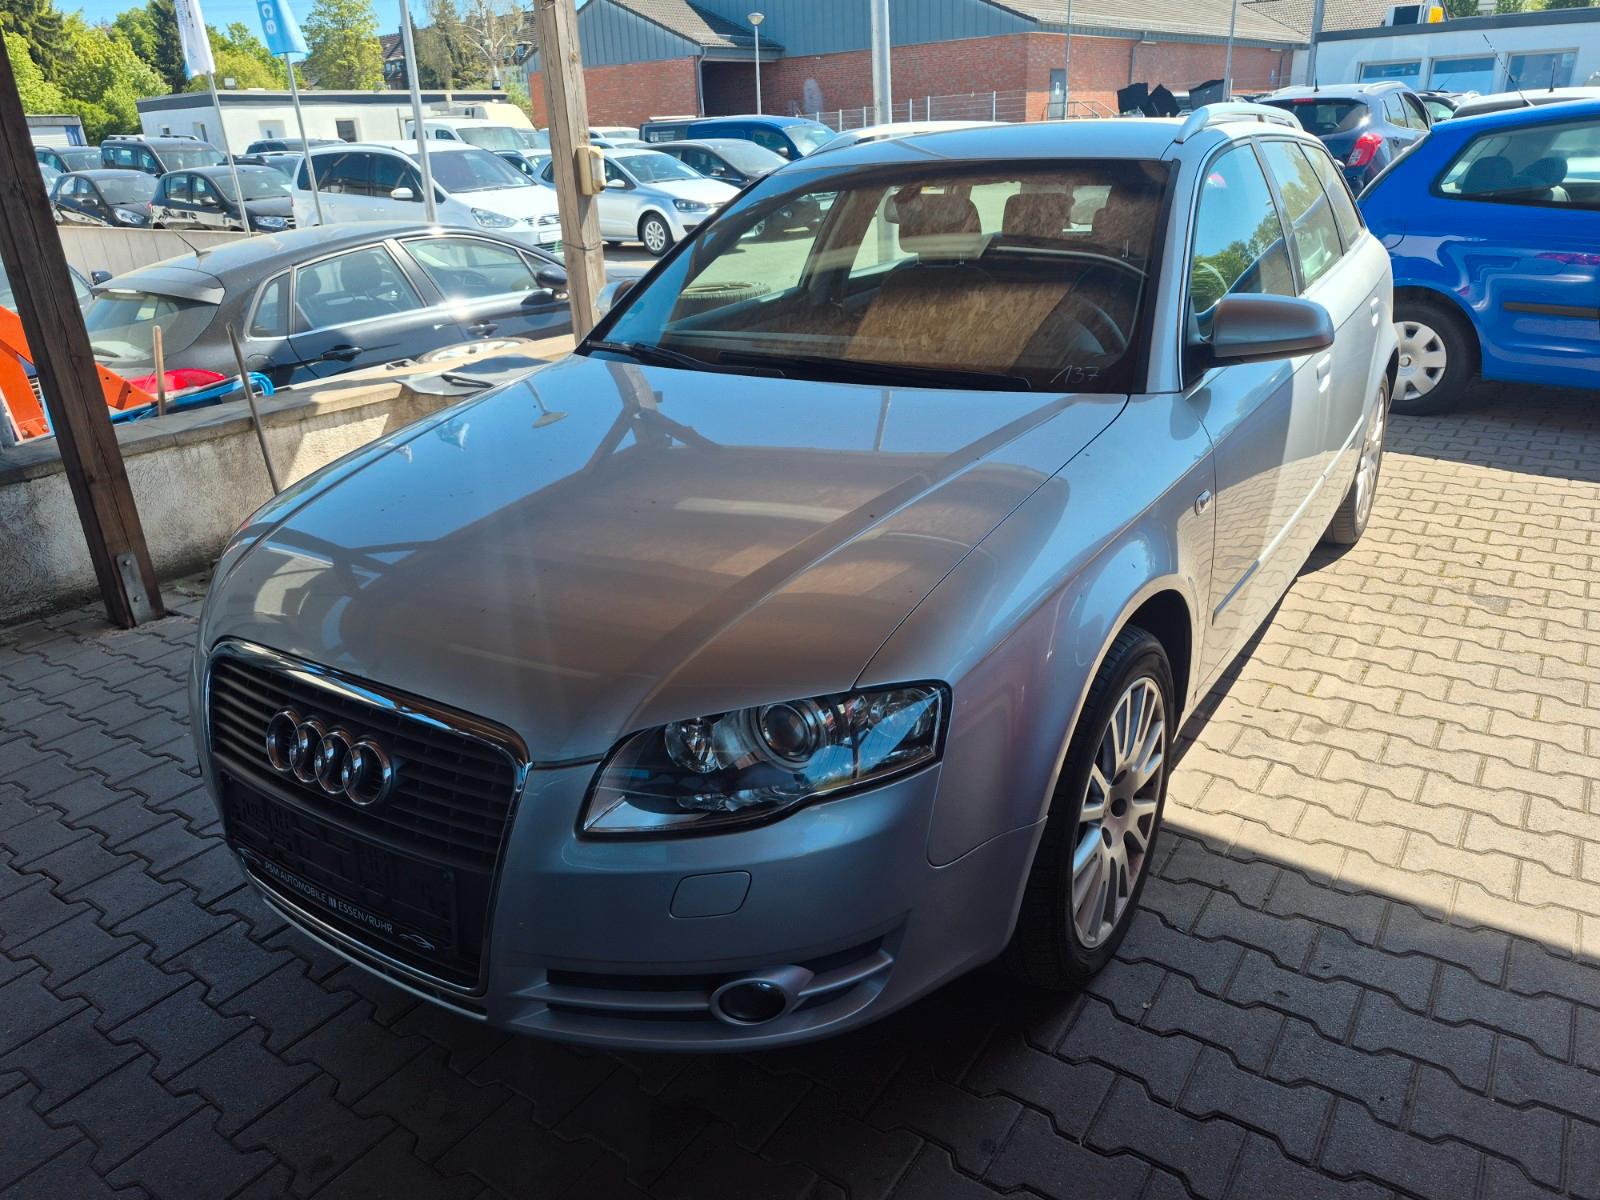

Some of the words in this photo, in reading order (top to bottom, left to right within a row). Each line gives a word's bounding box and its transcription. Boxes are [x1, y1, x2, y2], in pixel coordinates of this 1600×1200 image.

[1050, 365, 1099, 384] 137
[280, 872, 327, 903] AUTOMOBILE
[338, 901, 393, 934] ESSEN/RUHR
